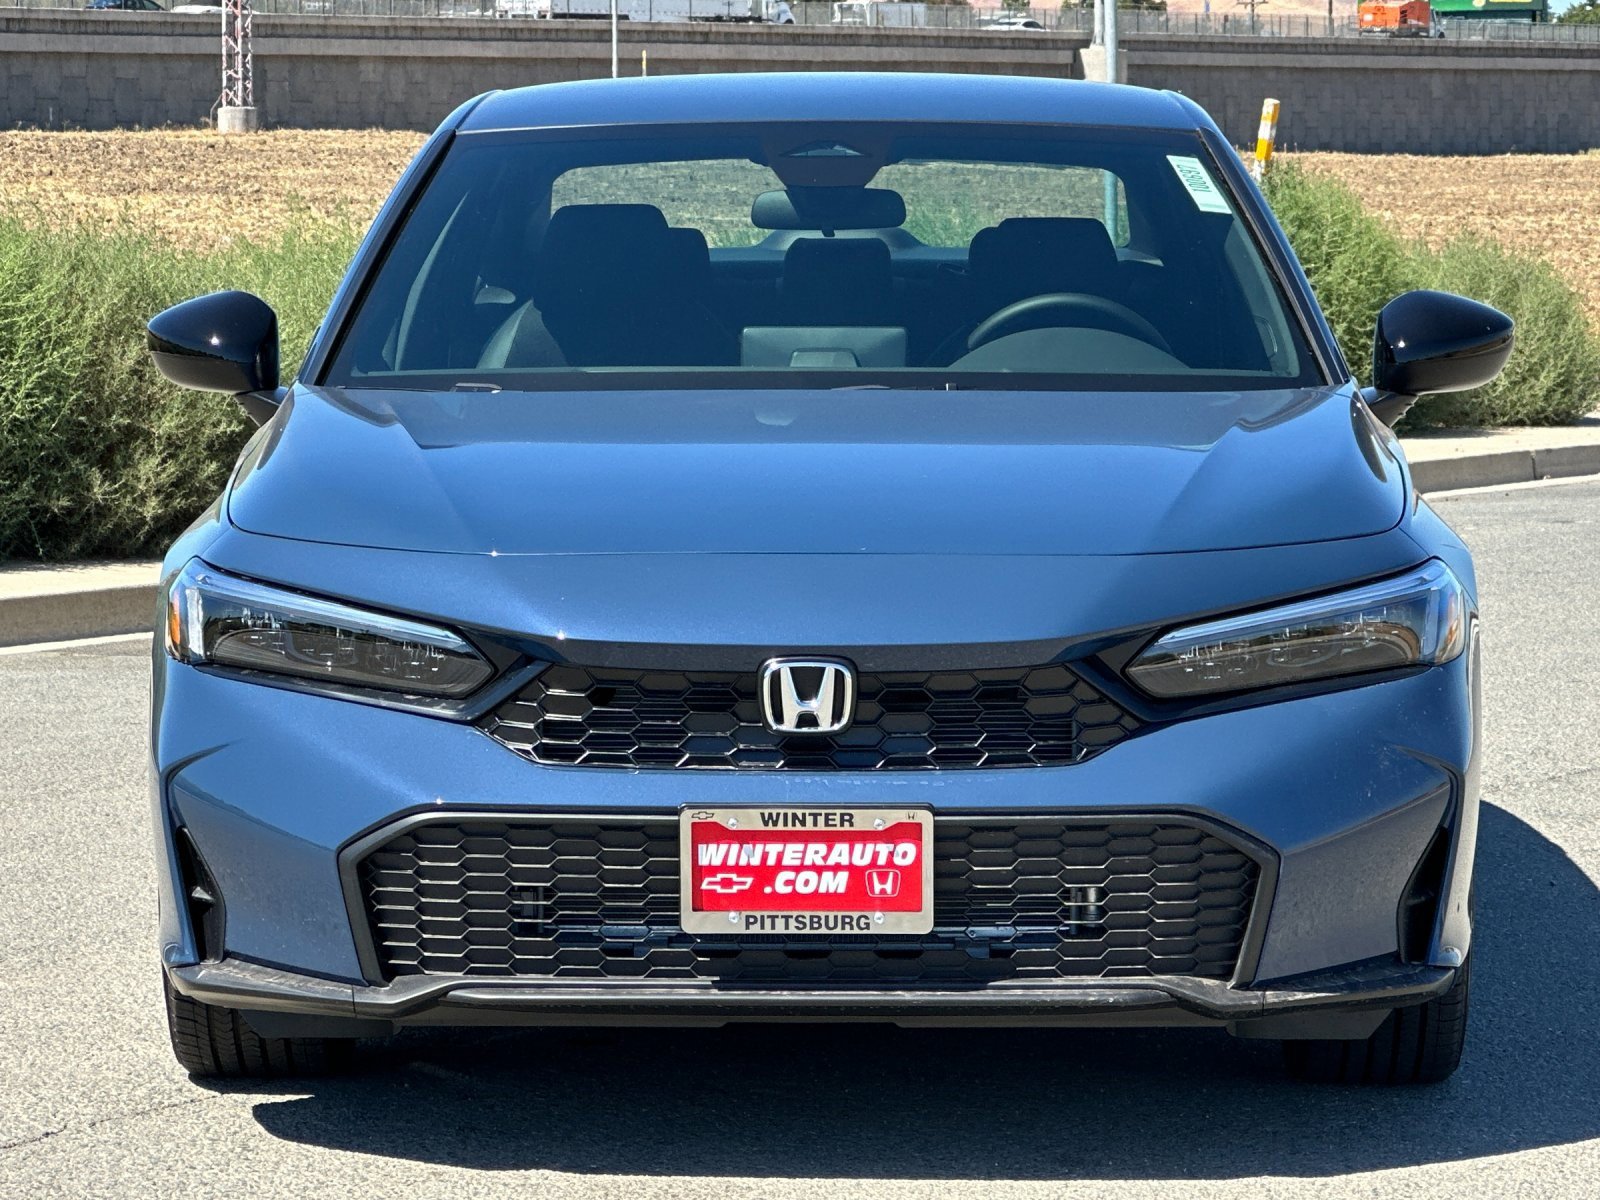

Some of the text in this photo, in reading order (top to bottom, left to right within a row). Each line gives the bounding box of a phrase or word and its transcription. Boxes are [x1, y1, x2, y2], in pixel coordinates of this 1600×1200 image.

[760, 812, 854, 828] WINTER
[698, 843, 917, 866] WINTERAUTO
[764, 871, 849, 894] .COM
[744, 914, 871, 931] PITTSBURG
